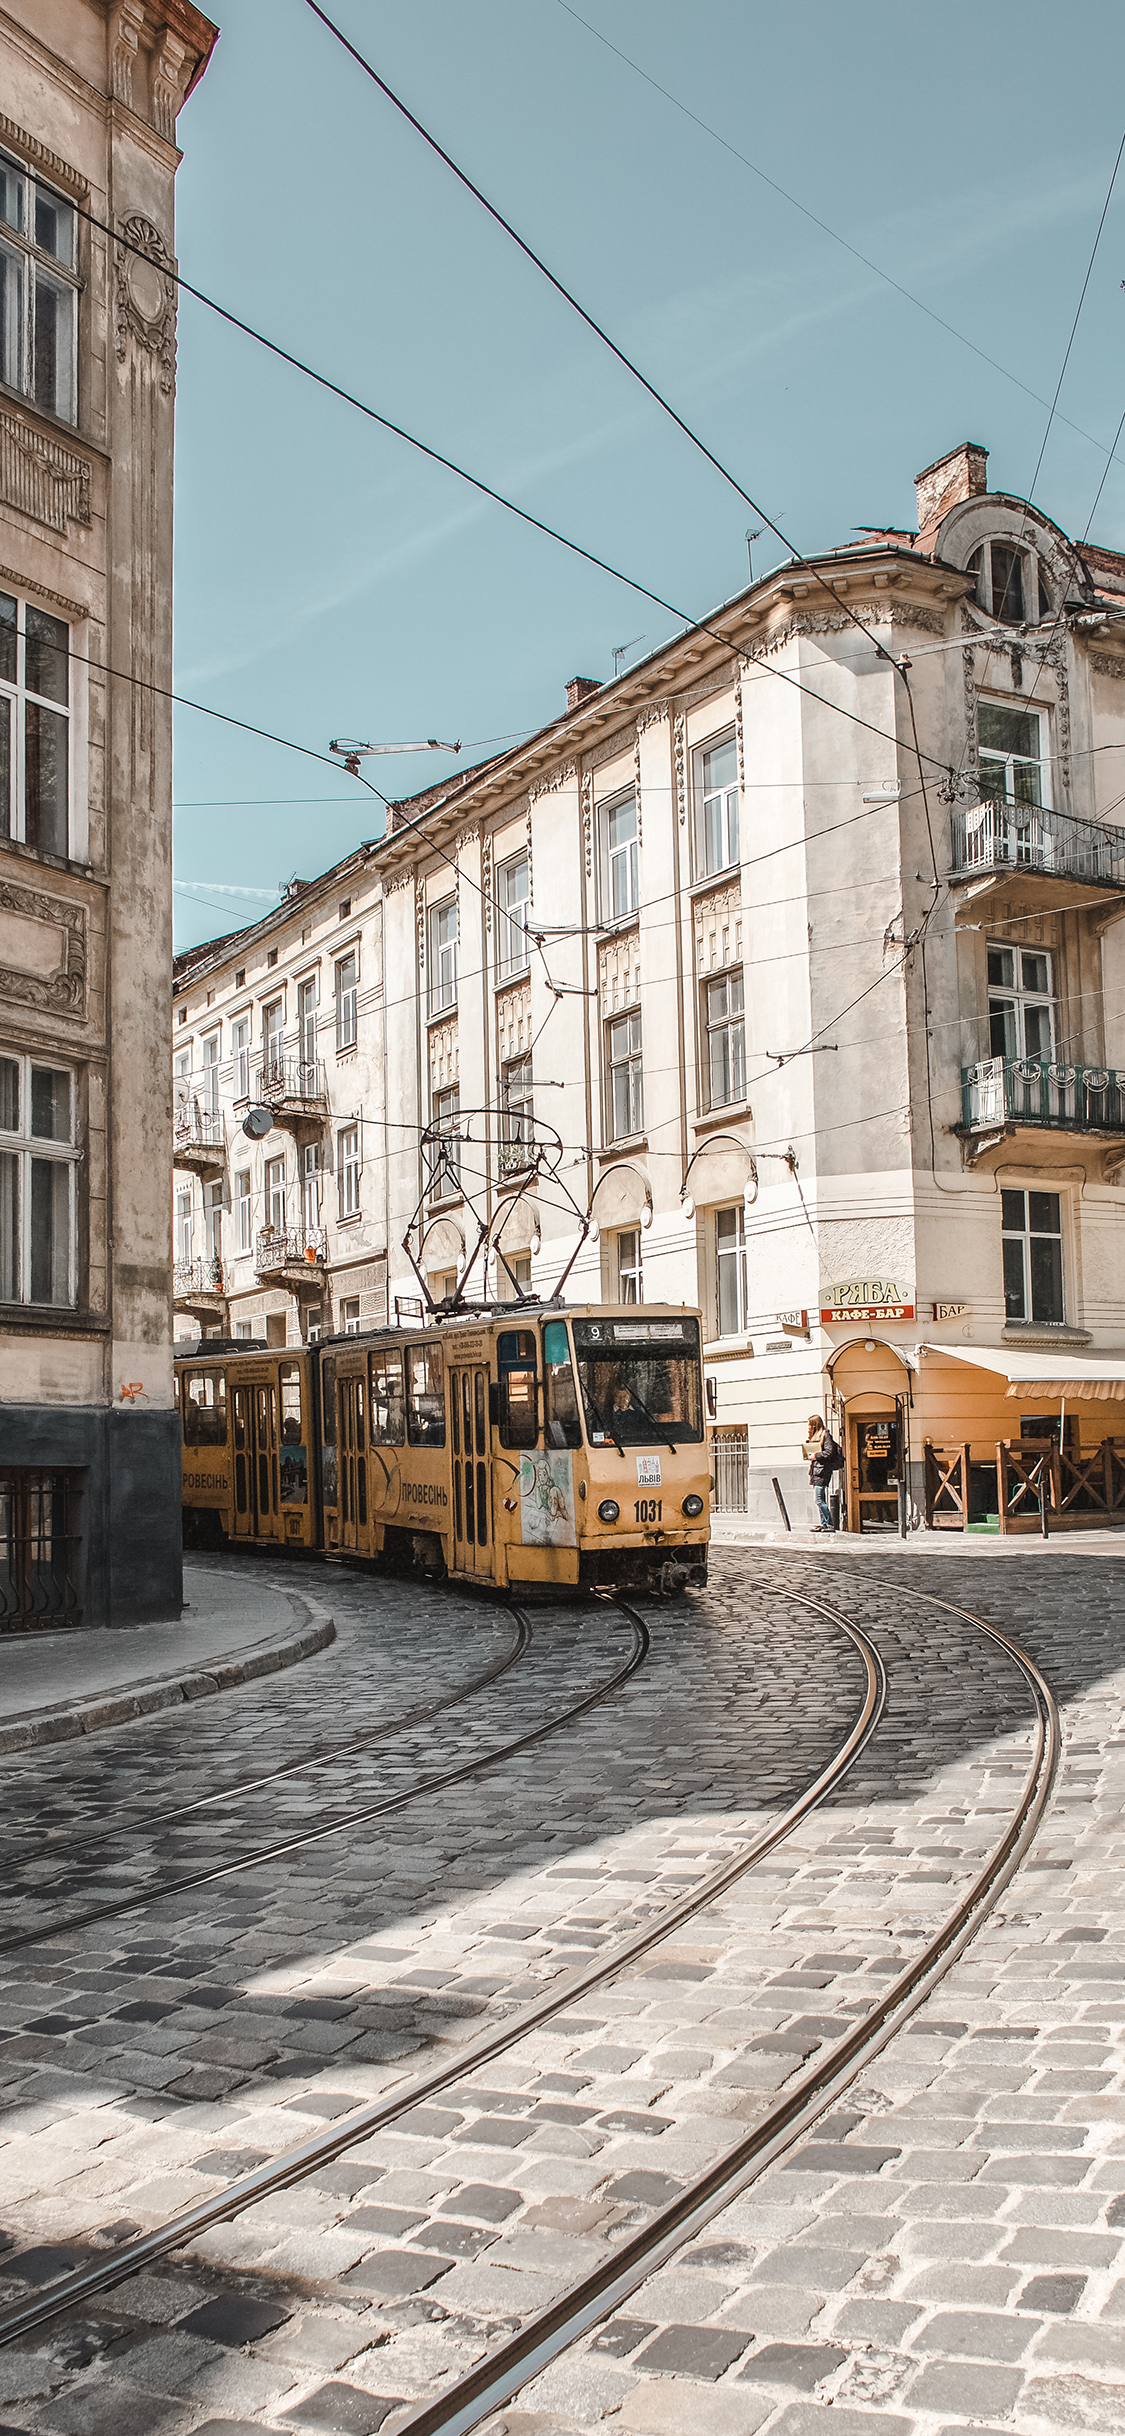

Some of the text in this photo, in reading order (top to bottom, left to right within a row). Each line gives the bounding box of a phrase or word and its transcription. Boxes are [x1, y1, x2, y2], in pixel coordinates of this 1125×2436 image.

[834, 1281, 901, 1305] РЯБА
[831, 1308, 905, 1321] КАФЕ-БАР
[939, 1305, 965, 1318] БАР
[776, 1312, 801, 1325] КАФЕ
[591, 1326, 600, 1339] 9
[183, 1473, 228, 1489] РОВЕСІНЬ
[638, 1474, 661, 1483] ЛЬВІВ
[402, 1483, 448, 1507] ПРОВЕСІНЬ
[634, 1499, 662, 1523] 1031
